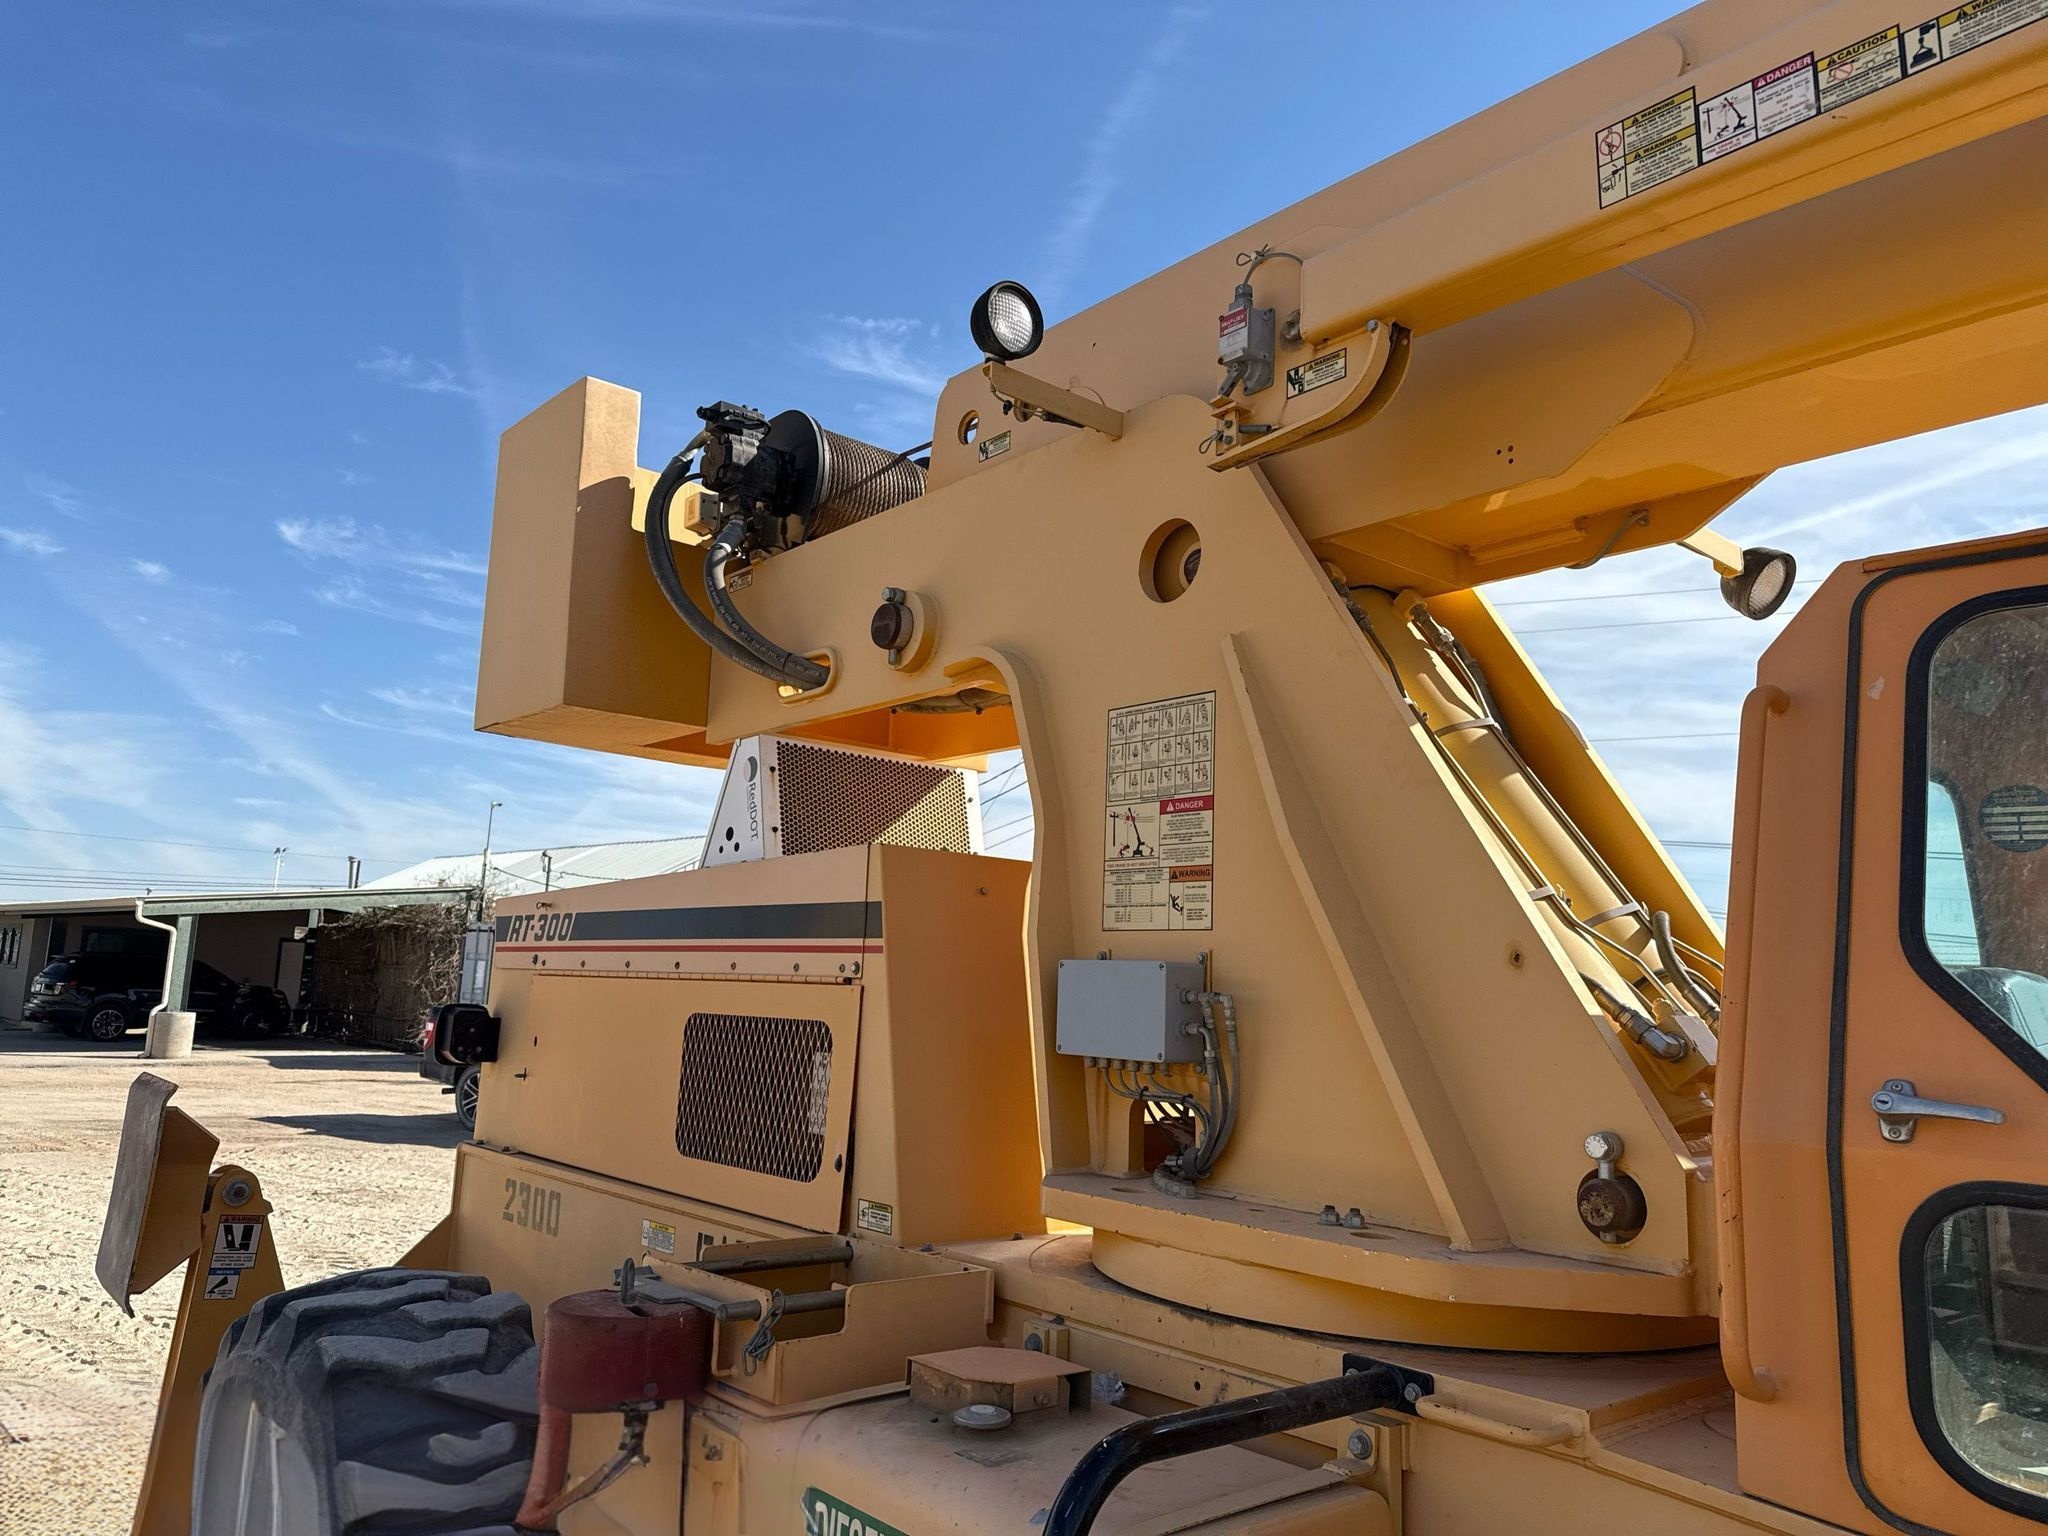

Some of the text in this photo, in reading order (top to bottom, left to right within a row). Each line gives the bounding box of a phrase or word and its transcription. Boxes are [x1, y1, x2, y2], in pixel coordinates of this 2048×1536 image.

[1837, 33, 1888, 60] CAUTION
[1766, 56, 1811, 81] DANGER
[1641, 100, 1675, 119] WARNING
[1643, 135, 1678, 154] WARNING
[1314, 352, 1341, 366] WARNING
[749, 782, 759, 839] RedDOT
[1175, 800, 1204, 810] DANGER
[1179, 869, 1211, 878] WARNING
[508, 912, 574, 942] RT-300
[502, 1178, 561, 1237] 2300
